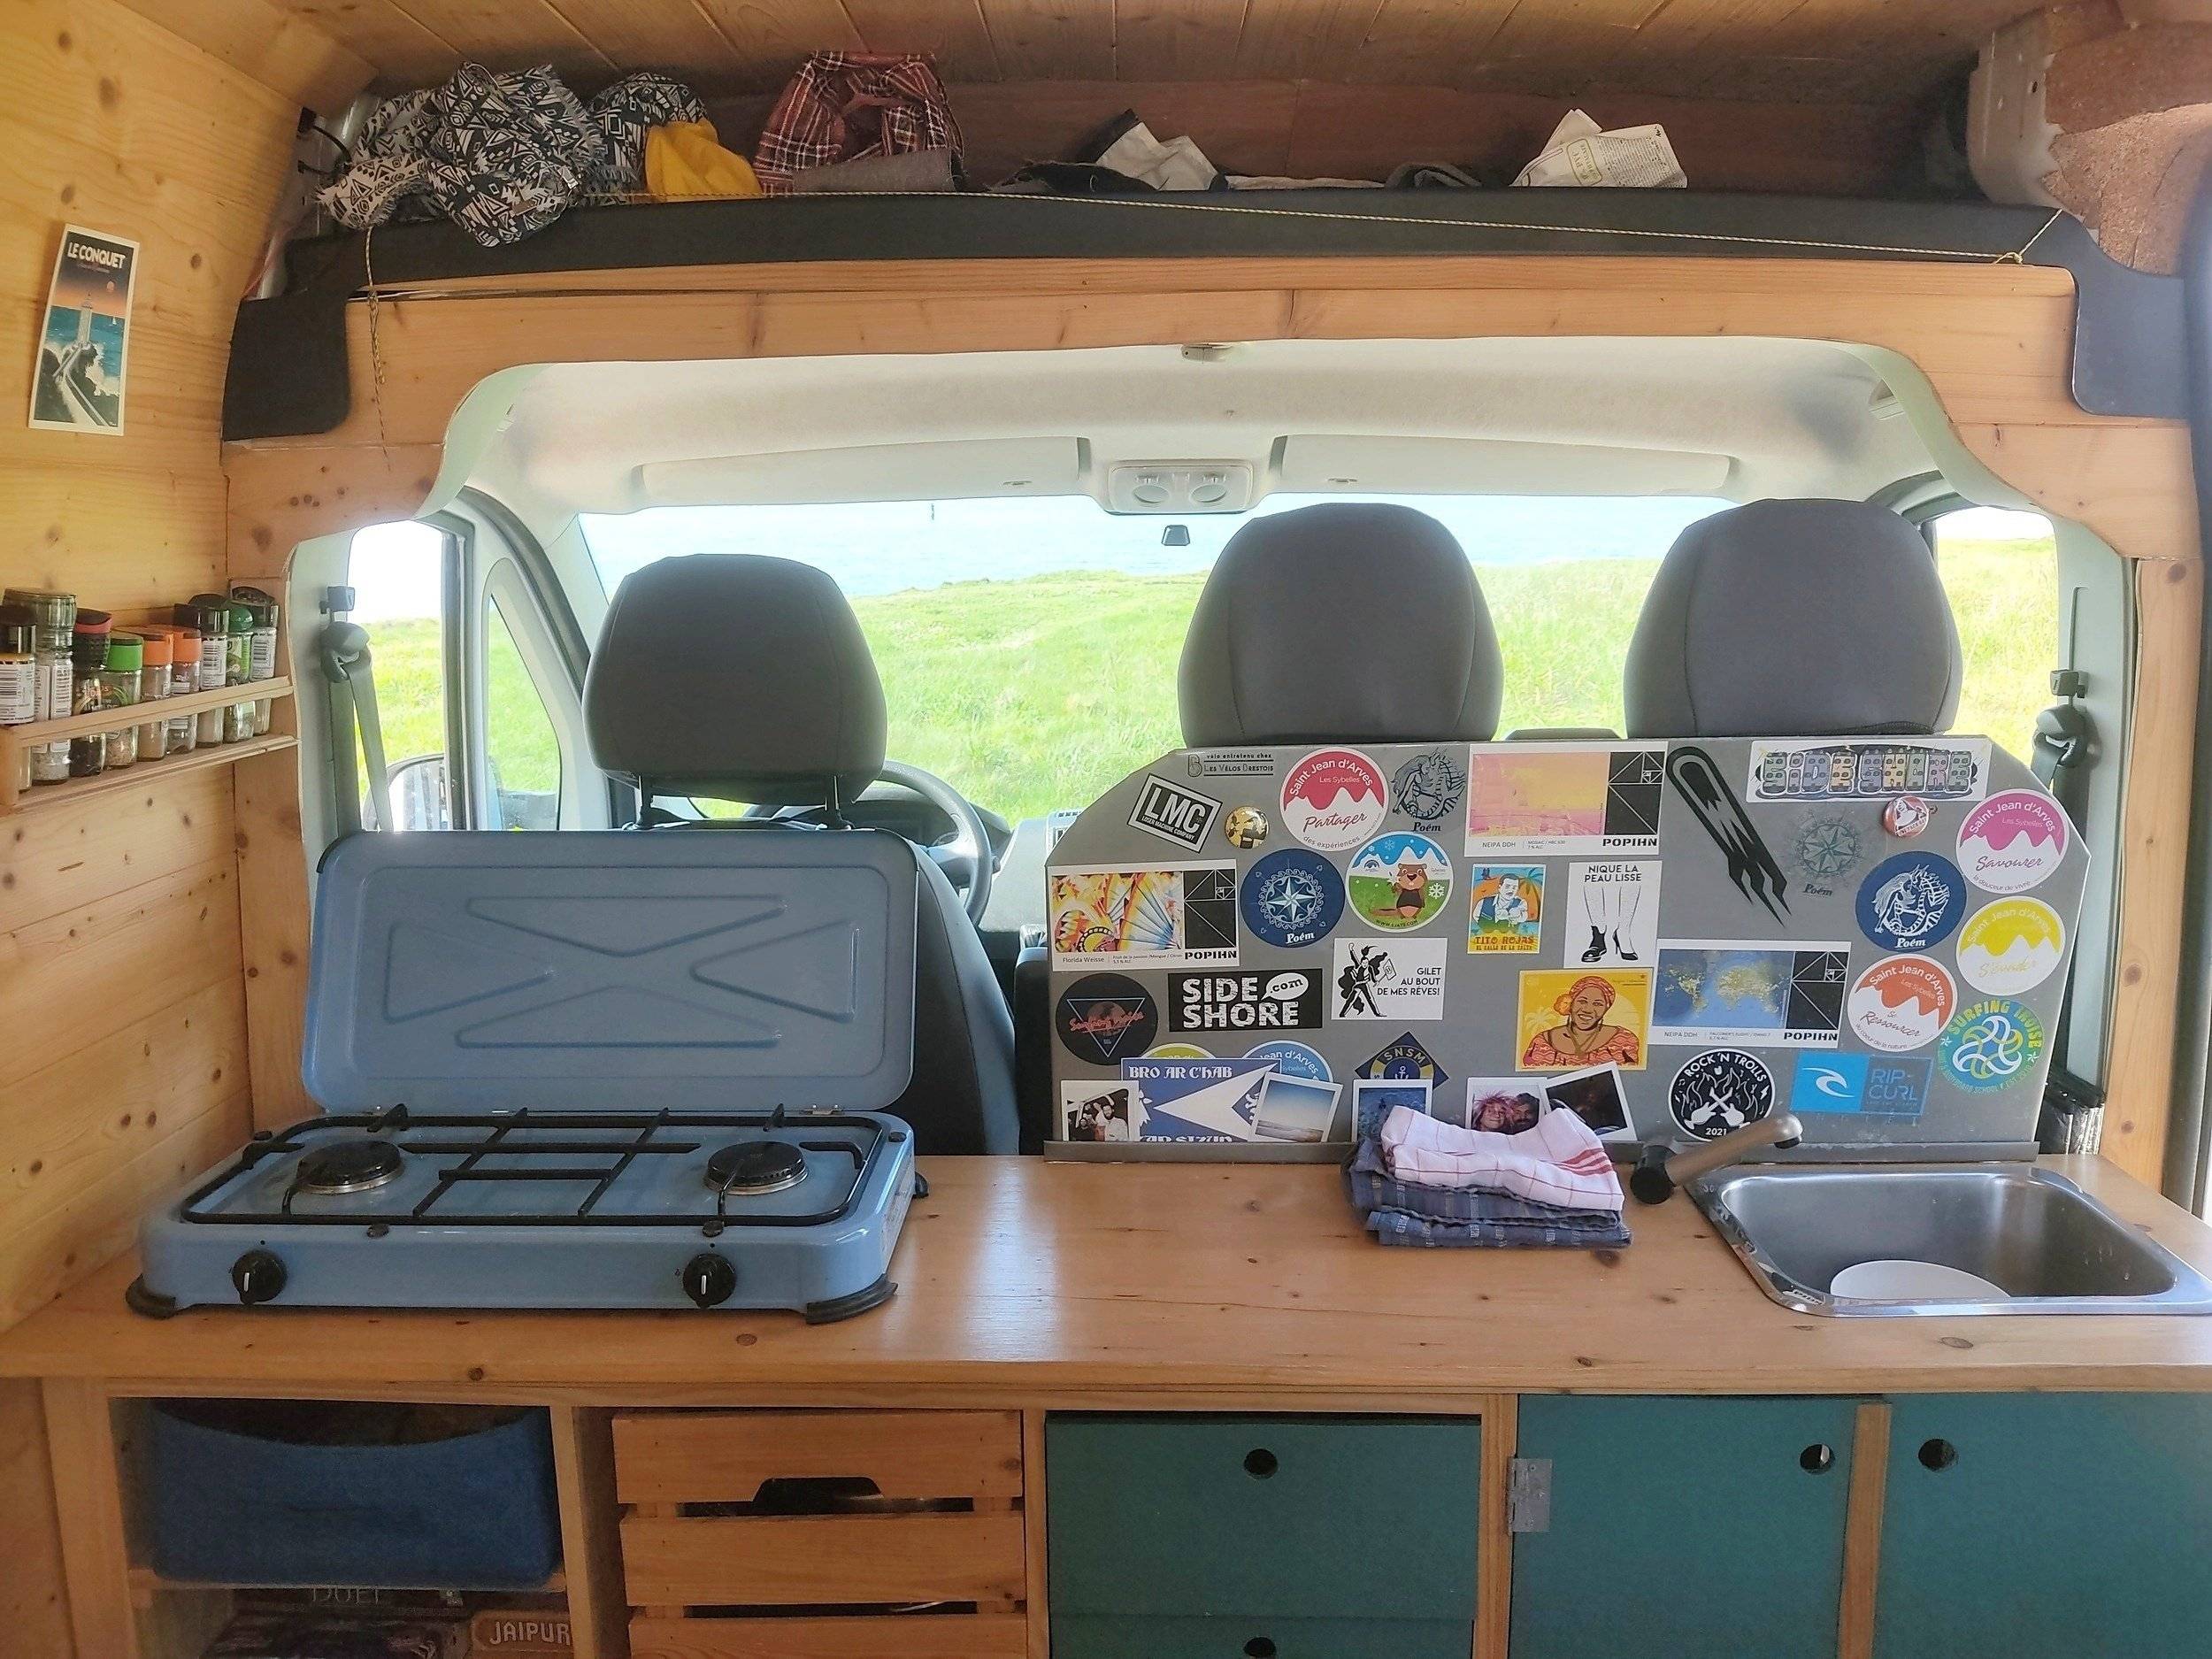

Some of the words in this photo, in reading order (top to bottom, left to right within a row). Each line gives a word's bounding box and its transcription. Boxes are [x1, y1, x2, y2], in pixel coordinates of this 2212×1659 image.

[67, 242, 80, 258] LE
[79, 244, 126, 268] CONQUET
[1289, 770, 1311, 795] Saint
[1310, 760, 1336, 774] Jean
[1338, 758, 1373, 787] d'Arves
[1144, 787, 1206, 833] LMC
[1970, 810, 1995, 833] Saint
[1995, 802, 2022, 813] Jean
[2024, 803, 2055, 832] d'Arves
[1302, 812, 1367, 833] Partager
[1412, 822, 1441, 833] Poém
[1173, 827, 1195, 841] COMPANY
[1303, 835, 1316, 845] des
[1317, 835, 1361, 849] expériences
[1602, 838, 1657, 847] POPIHN
[1588, 864, 1623, 873] NIQUE
[1975, 856, 2043, 872] Savourer
[1584, 874, 1613, 883] PEAU
[1615, 873, 1642, 882] LISSE
[1968, 920, 1989, 943] Saint
[1992, 909, 2016, 921] Jean
[1286, 932, 1315, 945] Poém
[1894, 938, 1926, 949] Poém
[1185, 951, 1237, 960] POPIHN
[1182, 977, 1259, 1003] SIDE
[1869, 967, 1898, 985] Saint
[1898, 964, 1924, 977] Jean
[1924, 973, 1946, 1007] d'Arves
[1182, 1002, 1299, 1029] SHORE
[1947, 1000, 2010, 1035] SURFING
[1784, 1032, 1838, 1041] POPIHN
[1285, 1049, 1319, 1073] d'Arves
[1384, 1047, 1426, 1064] SNSM
[1128, 1066, 1161, 1079] BRO
[1164, 1066, 1187, 1079] AR
[1683, 1056, 1716, 1077] ROCK
[1734, 1054, 1767, 1082] TROLLS
[1869, 1085, 1917, 1101] CURL
[489, 1621, 571, 1646] JAIPUR
